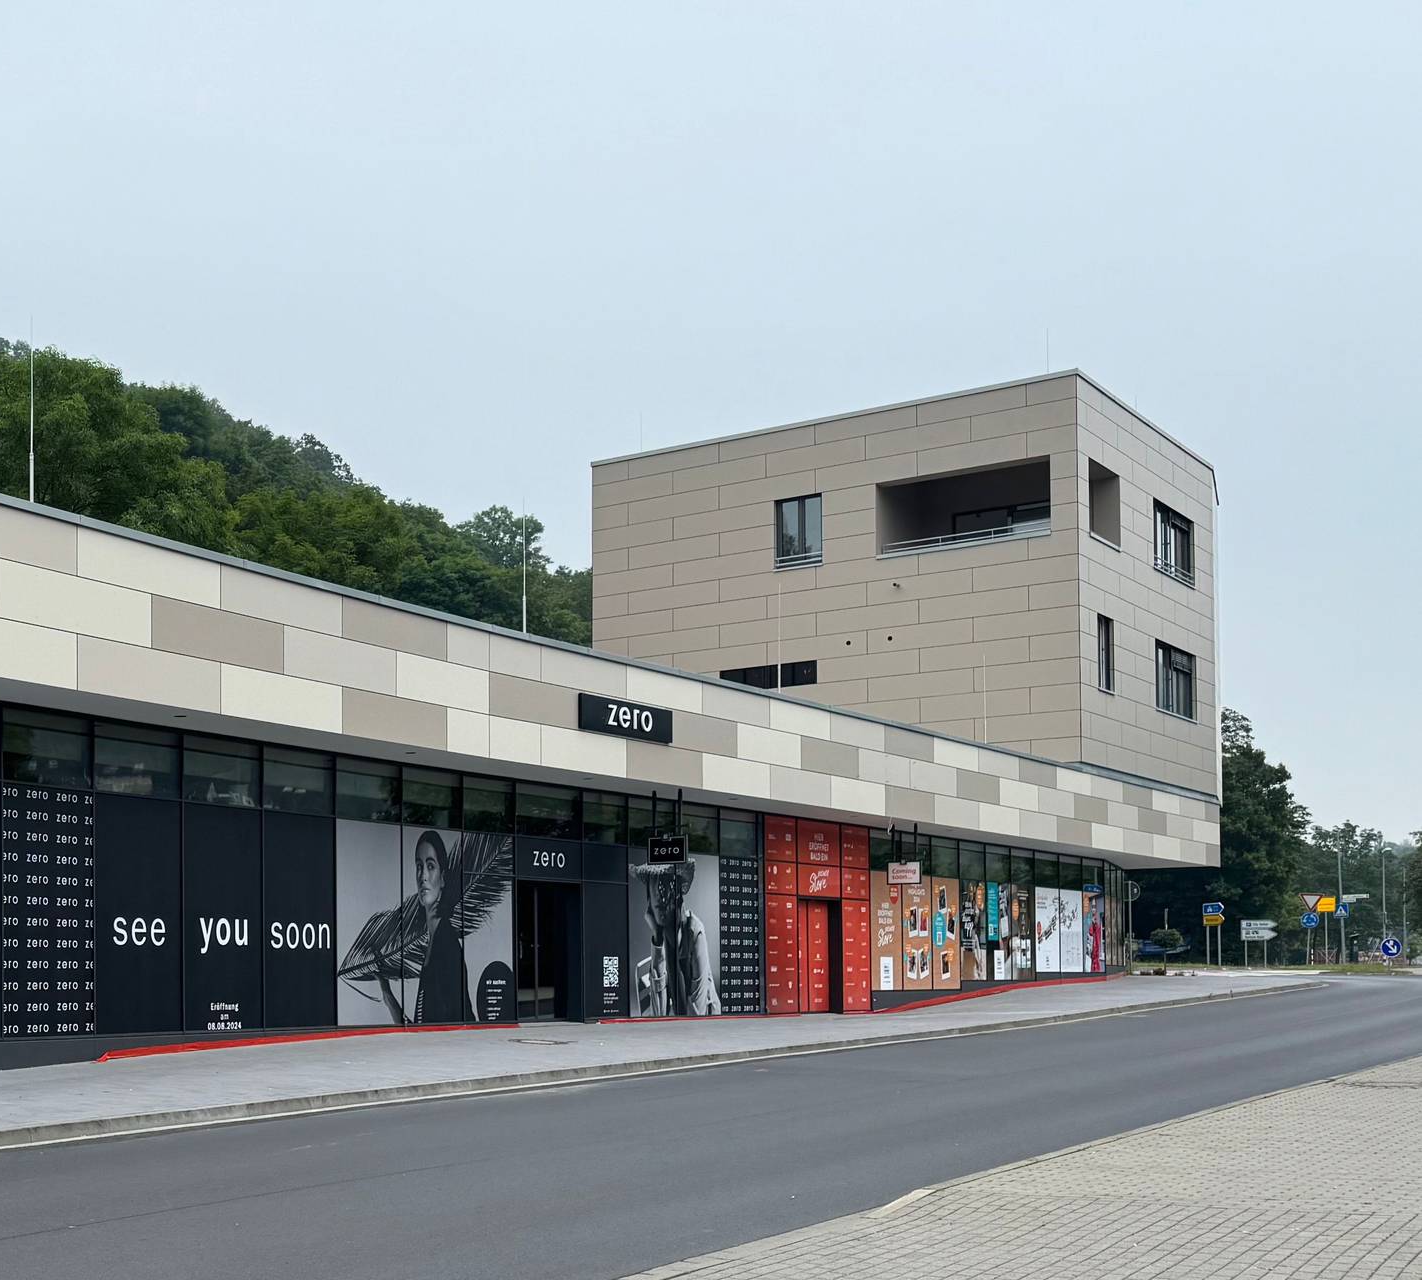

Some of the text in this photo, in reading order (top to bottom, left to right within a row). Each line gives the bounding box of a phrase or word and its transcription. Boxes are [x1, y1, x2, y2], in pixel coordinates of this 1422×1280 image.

[607, 704, 653, 733] zero
[27, 790, 48, 799] zero
[57, 793, 77, 802] zero
[27, 811, 48, 821] zero
[57, 814, 77, 823] zero
[27, 833, 48, 842] zero
[57, 835, 77, 844] zero
[653, 847, 680, 855] zero
[27, 854, 48, 863] zero
[57, 856, 77, 865] zero
[533, 850, 566, 868] zero
[27, 875, 48, 884] zero
[57, 877, 77, 886] zero
[27, 897, 48, 905] zero
[57, 898, 78, 906] zero
[27, 918, 48, 926] zero
[57, 919, 78, 927] zero
[113, 916, 331, 954] see you soon
[27, 939, 48, 947] zero
[57, 940, 78, 948] zero
[57, 961, 78, 969] zero
[27, 982, 49, 990] zero
[57, 982, 78, 990] zero
[27, 1003, 49, 1011] zero
[57, 1003, 78, 1011] zero
[27, 1024, 49, 1033] zero
[58, 1024, 78, 1032] zero
[208, 1021, 242, 1030] 08.08.2024
